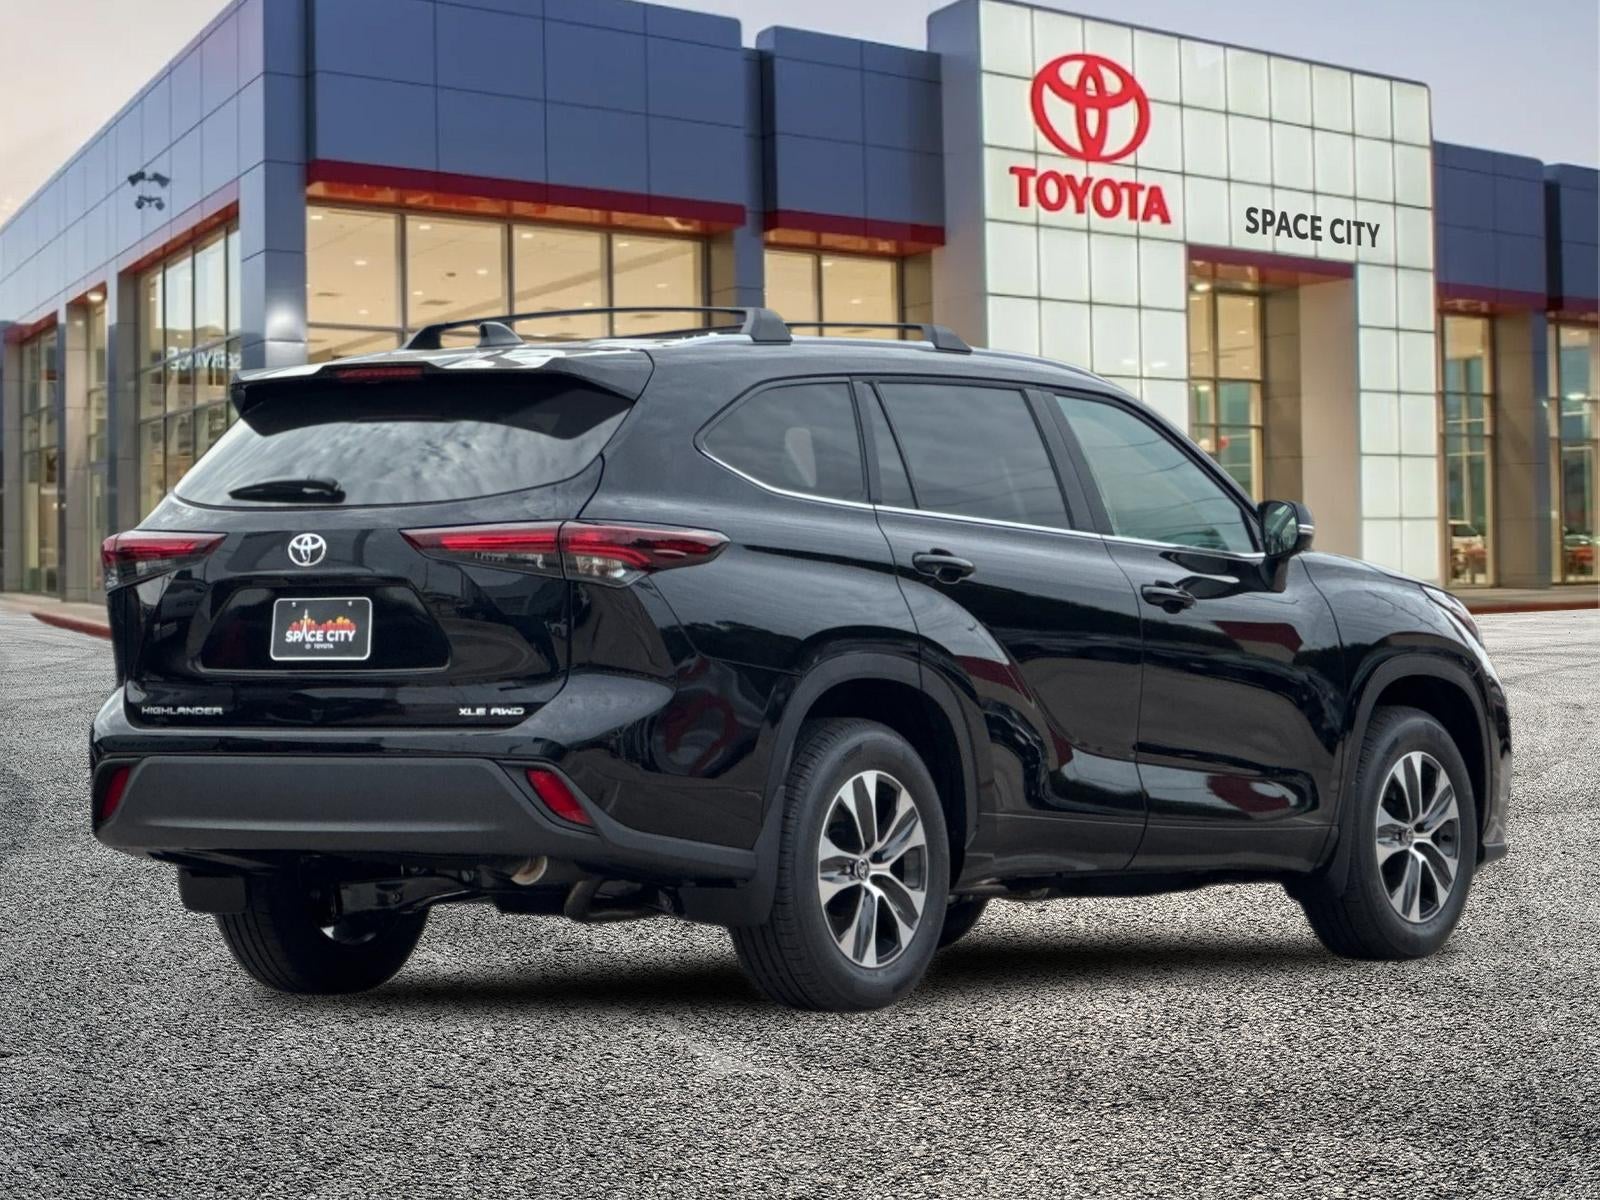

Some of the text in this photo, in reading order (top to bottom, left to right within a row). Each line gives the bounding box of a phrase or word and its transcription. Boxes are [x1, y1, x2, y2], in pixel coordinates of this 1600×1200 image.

[1009, 166, 1171, 224] TOYOTA
[1245, 207, 1380, 247] SPACE CITY
[285, 630, 356, 642] SPACE CITY
[141, 706, 223, 715] HIGHLANDER
[459, 707, 524, 715] XLE AWD
